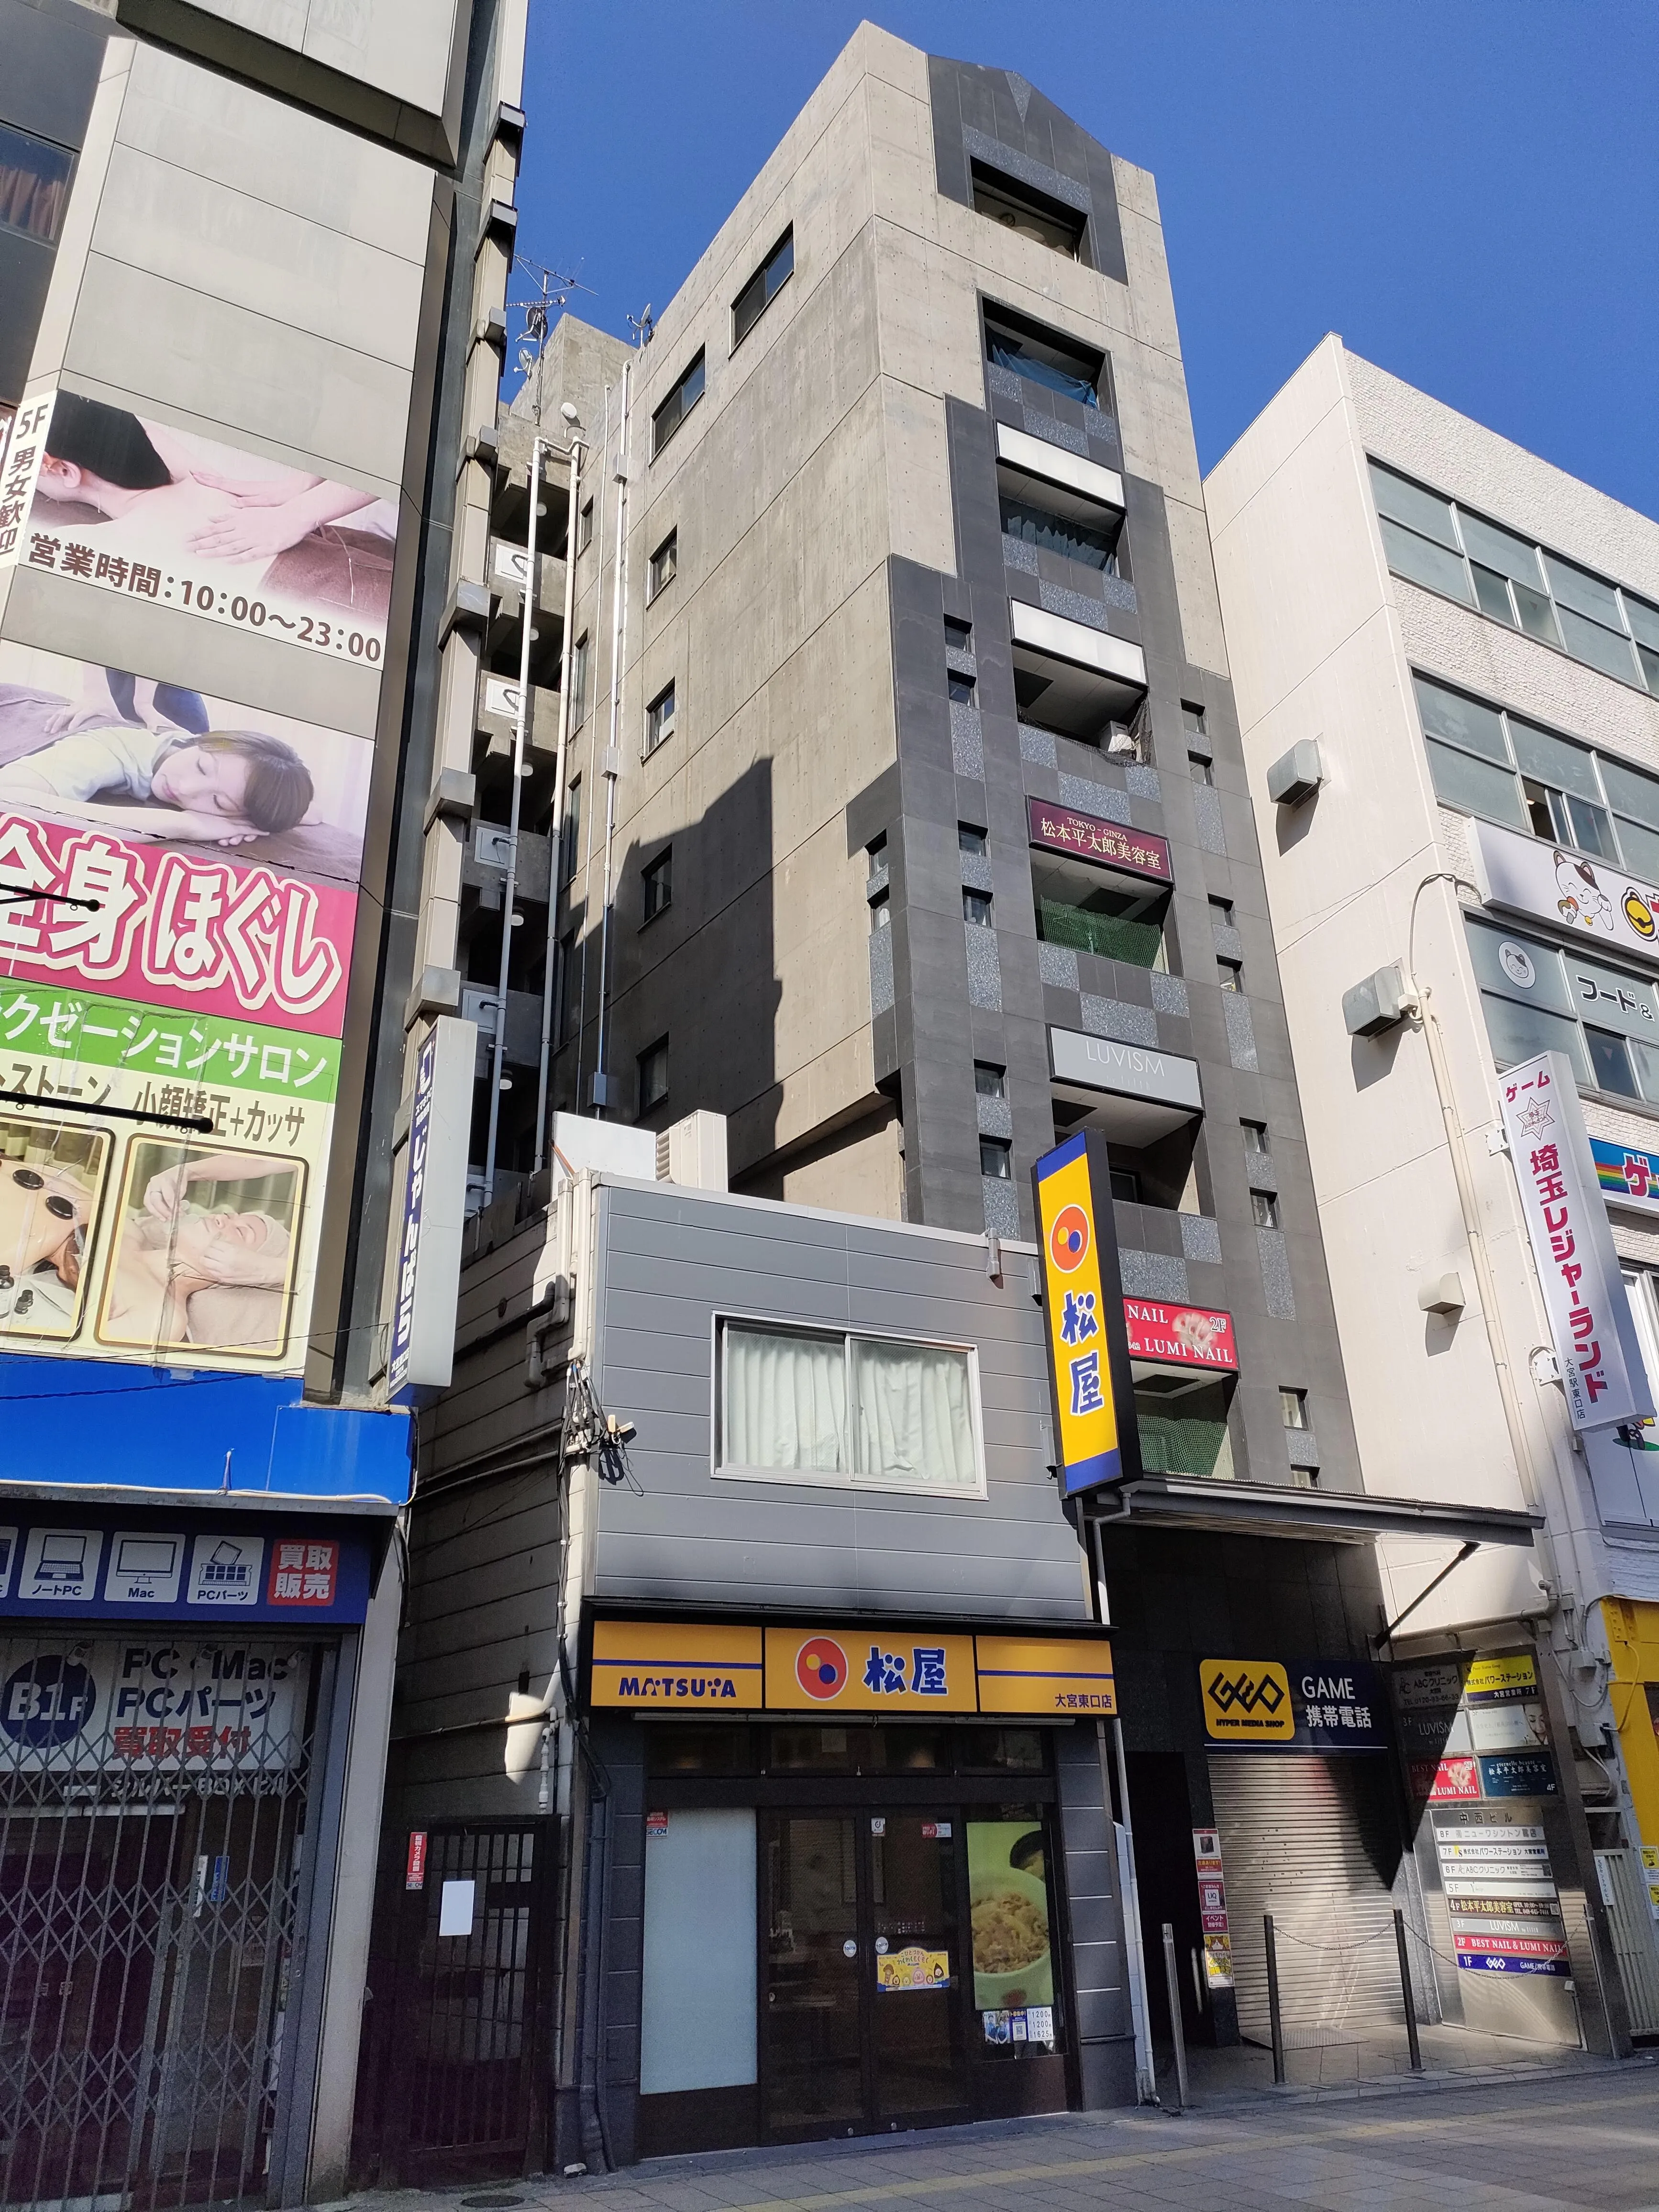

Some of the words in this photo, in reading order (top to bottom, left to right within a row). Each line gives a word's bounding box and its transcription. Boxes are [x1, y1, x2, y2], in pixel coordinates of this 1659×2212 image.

[16, 404, 49, 440] 5F
[1067, 817, 1095, 831] TOKYO
[1103, 829, 1128, 841] GINZA
[1041, 817, 1161, 870] 松本平太郎美容室
[0, 819, 336, 1002] 全身ほぐし
[0, 994, 327, 1088] クゼーションサロン
[1086, 1040, 1164, 1077] LUVISM
[0, 1062, 111, 1116] ストーン
[1506, 1070, 1550, 1103] ゲーム
[397, 1124, 427, 1347] じゃんぱら
[1530, 1142, 1609, 1404] 埼玉レジャーランド
[1127, 1305, 1168, 1324] NAIL
[1209, 1316, 1227, 1333] 2F
[1060, 1289, 1105, 1417] 松屋
[1144, 1338, 1188, 1357] LUMI
[1192, 1345, 1233, 1363] NAIL
[1564, 1357, 1586, 1420] 大宮駅東口店
[278, 1543, 332, 1571] 買取
[32, 1584, 82, 1596] ノートPC
[128, 1588, 155, 1599] Mac
[197, 1589, 249, 1602] PCパーツ
[273, 1573, 331, 1601] 販売
[863, 1646, 948, 1696] 松屋
[1414, 1675, 1458, 1689] ABCクリニック
[619, 1677, 736, 1698] MATSUYA
[1208, 1672, 1285, 1714] GEO
[1301, 1676, 1356, 1700] GAME
[1493, 1689, 1522, 1698] 大宮営業所
[7, 1681, 88, 1721] B1F
[116, 1686, 276, 1720] PCパーツ
[1054, 1693, 1112, 1709] 大宮東口店
[1216, 1718, 1240, 1727] HYPER
[1241, 1719, 1264, 1727] MEDIA
[1265, 1720, 1285, 1728] SHOP
[1305, 1704, 1372, 1728] 携帯電話
[1419, 1723, 1454, 1736] LUVISM
[112, 1725, 251, 1760] 買取受付
[1464, 1761, 1473, 1771] 2F
[1437, 1786, 1456, 1796] LUMI
[1458, 1786, 1477, 1795] NAIL
[1547, 1783, 1556, 1792] 4F
[1459, 1812, 1513, 1824] 中西ビル
[1463, 1847, 1522, 1856] 株式会社パワーステーション
[1449, 1883, 1459, 1892] 5F
[1450, 1902, 1460, 1911] 4F
[1460, 1900, 1515, 1913] 松本平太郎美容室
[1489, 1920, 1519, 1932] LUVISM
[1457, 1937, 1466, 1947] 2F
[1471, 1939, 1490, 1948] BEST
[1492, 1940, 1512, 1949] NAIL
[1513, 1941, 1518, 1950] &
[1520, 1941, 1541, 1951] LUMI
[1463, 1956, 1472, 1967] 1F
[1486, 1957, 1506, 1969] GEO
